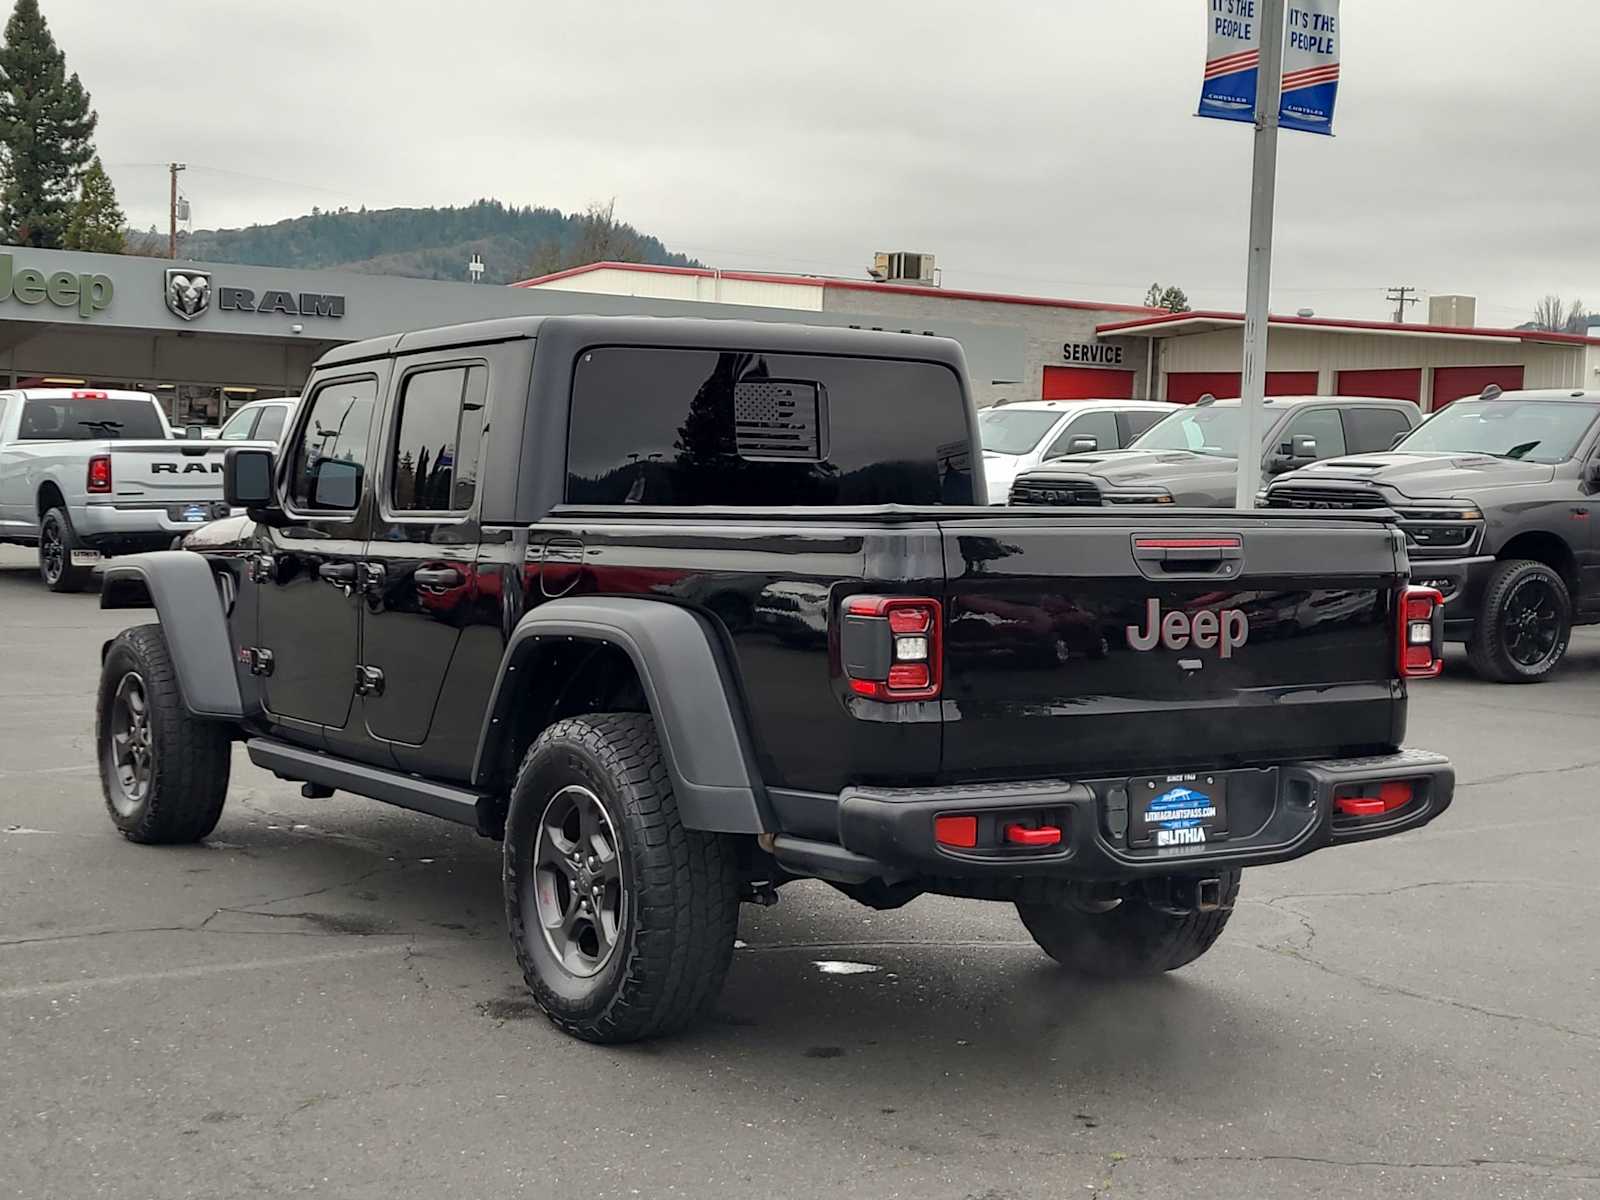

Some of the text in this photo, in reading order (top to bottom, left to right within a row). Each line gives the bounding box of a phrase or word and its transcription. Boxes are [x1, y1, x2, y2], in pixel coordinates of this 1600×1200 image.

[1236, 0, 1254, 18] THE
[1215, 17, 1251, 40] PEOPLE
[1290, 8, 1335, 33] IT'S THE
[1290, 32, 1334, 54] PEOPLE
[1209, 94, 1247, 102] CHRYSLER
[1288, 105, 1323, 115] CHRYSLER
[219, 287, 345, 318] RAM
[1063, 343, 1122, 364] SERVICE
[1126, 597, 1249, 659] Jeep
[1169, 827, 1206, 844] LITHIA
